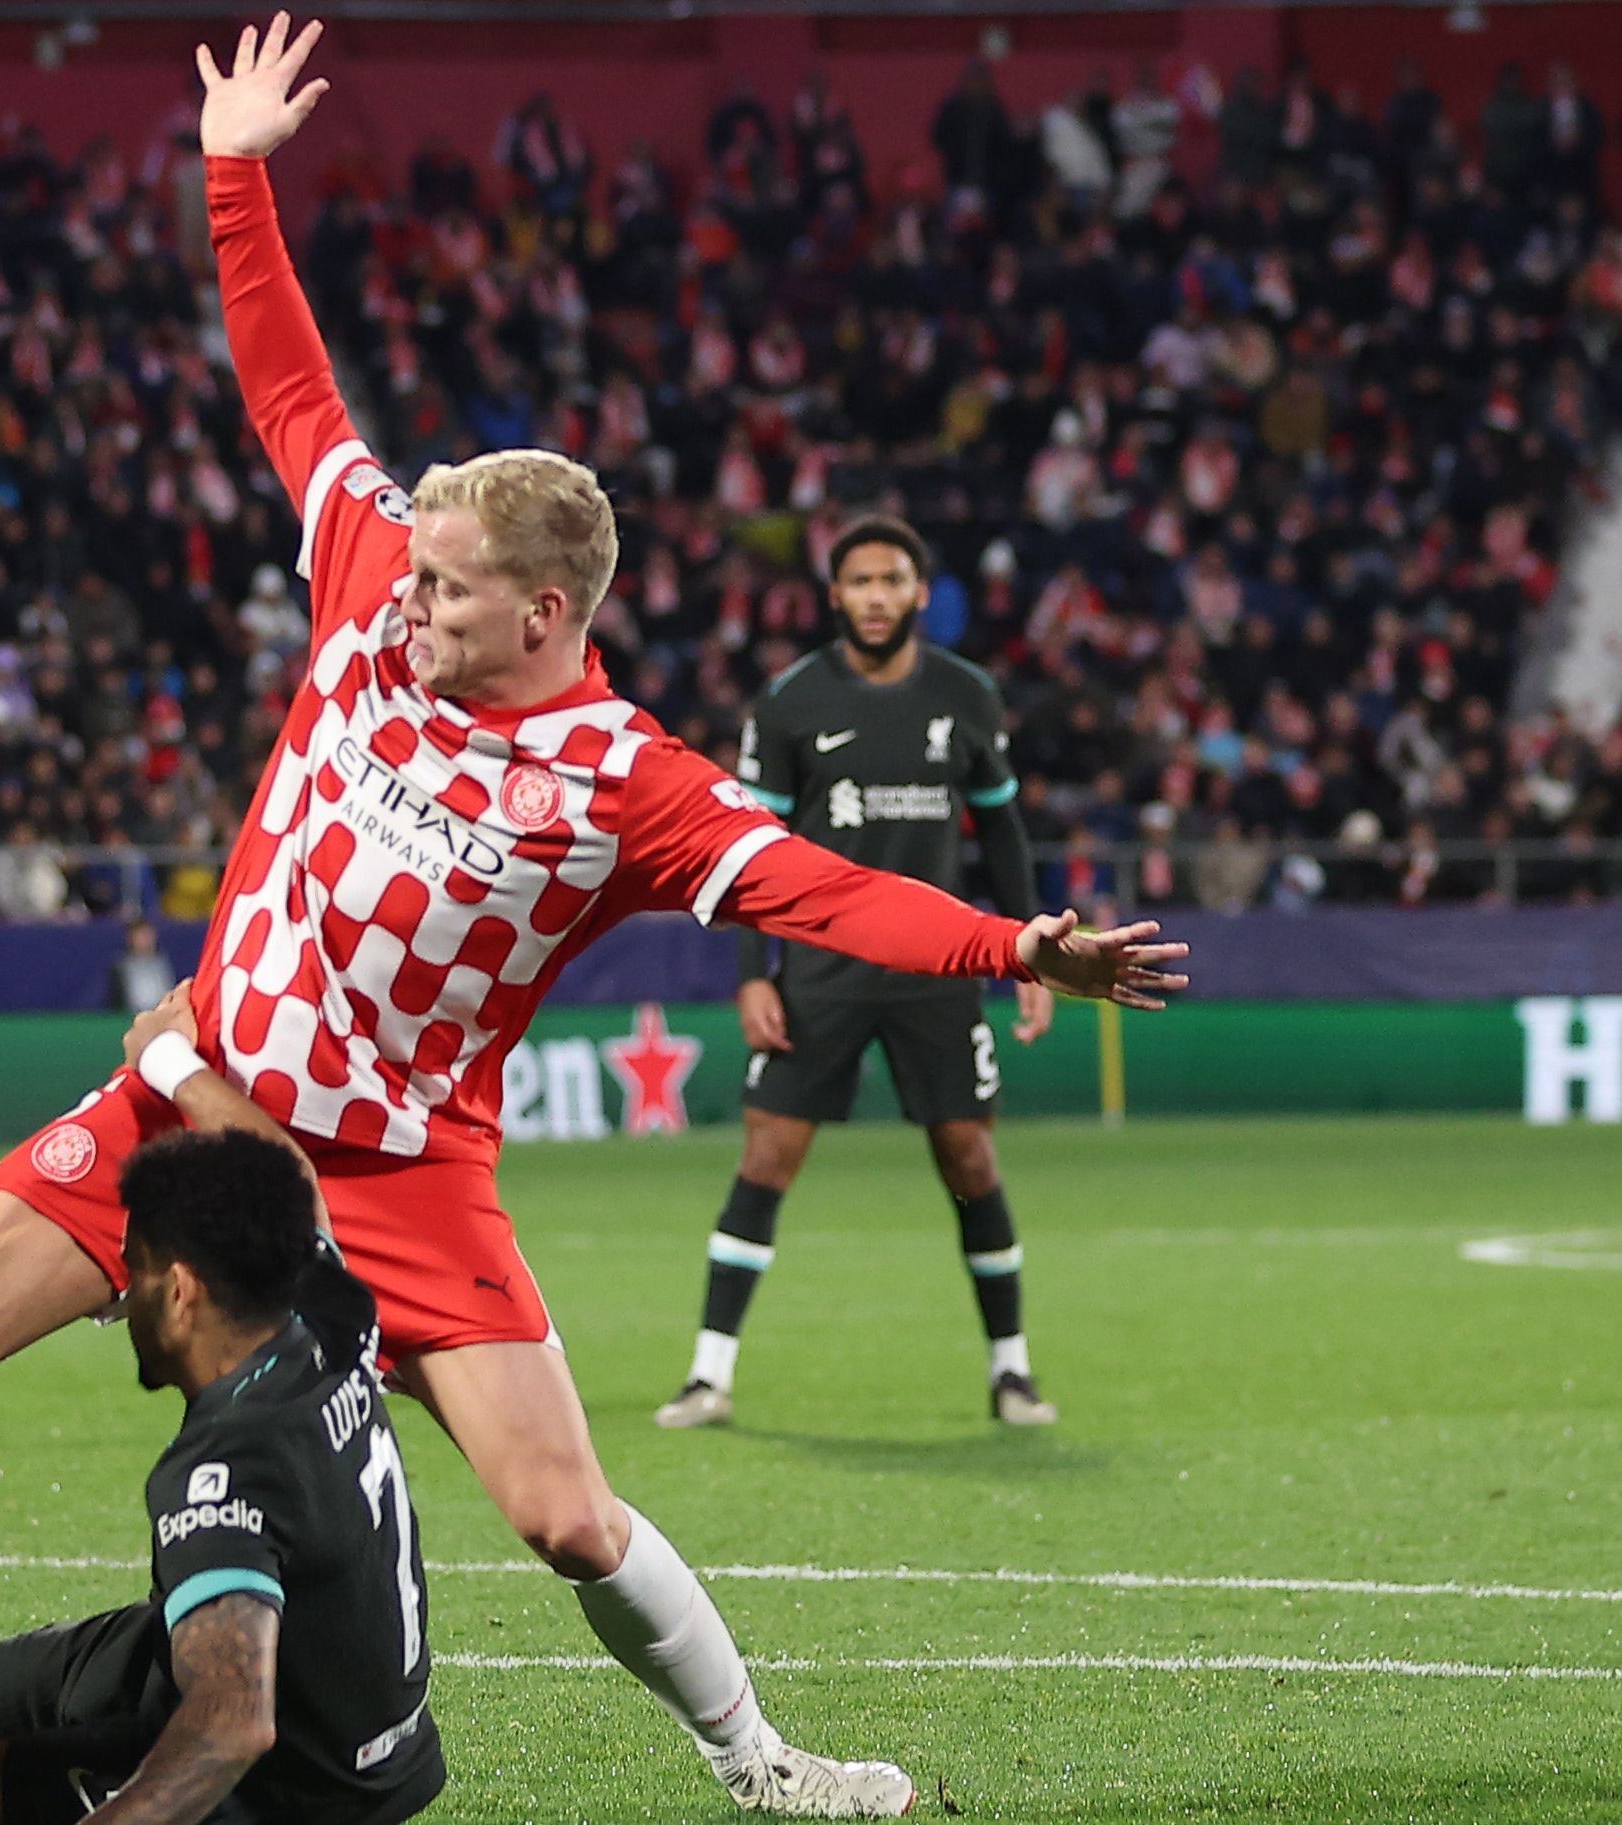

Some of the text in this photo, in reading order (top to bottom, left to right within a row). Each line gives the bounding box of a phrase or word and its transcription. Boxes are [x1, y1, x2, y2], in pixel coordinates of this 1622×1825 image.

[336, 737, 504, 876] ETIHAD
[341, 800, 444, 881] AIRWAYS
[321, 1367, 372, 1453] LUIS
[158, 1497, 264, 1549] Expedia
[359, 1423, 422, 1677] 7
